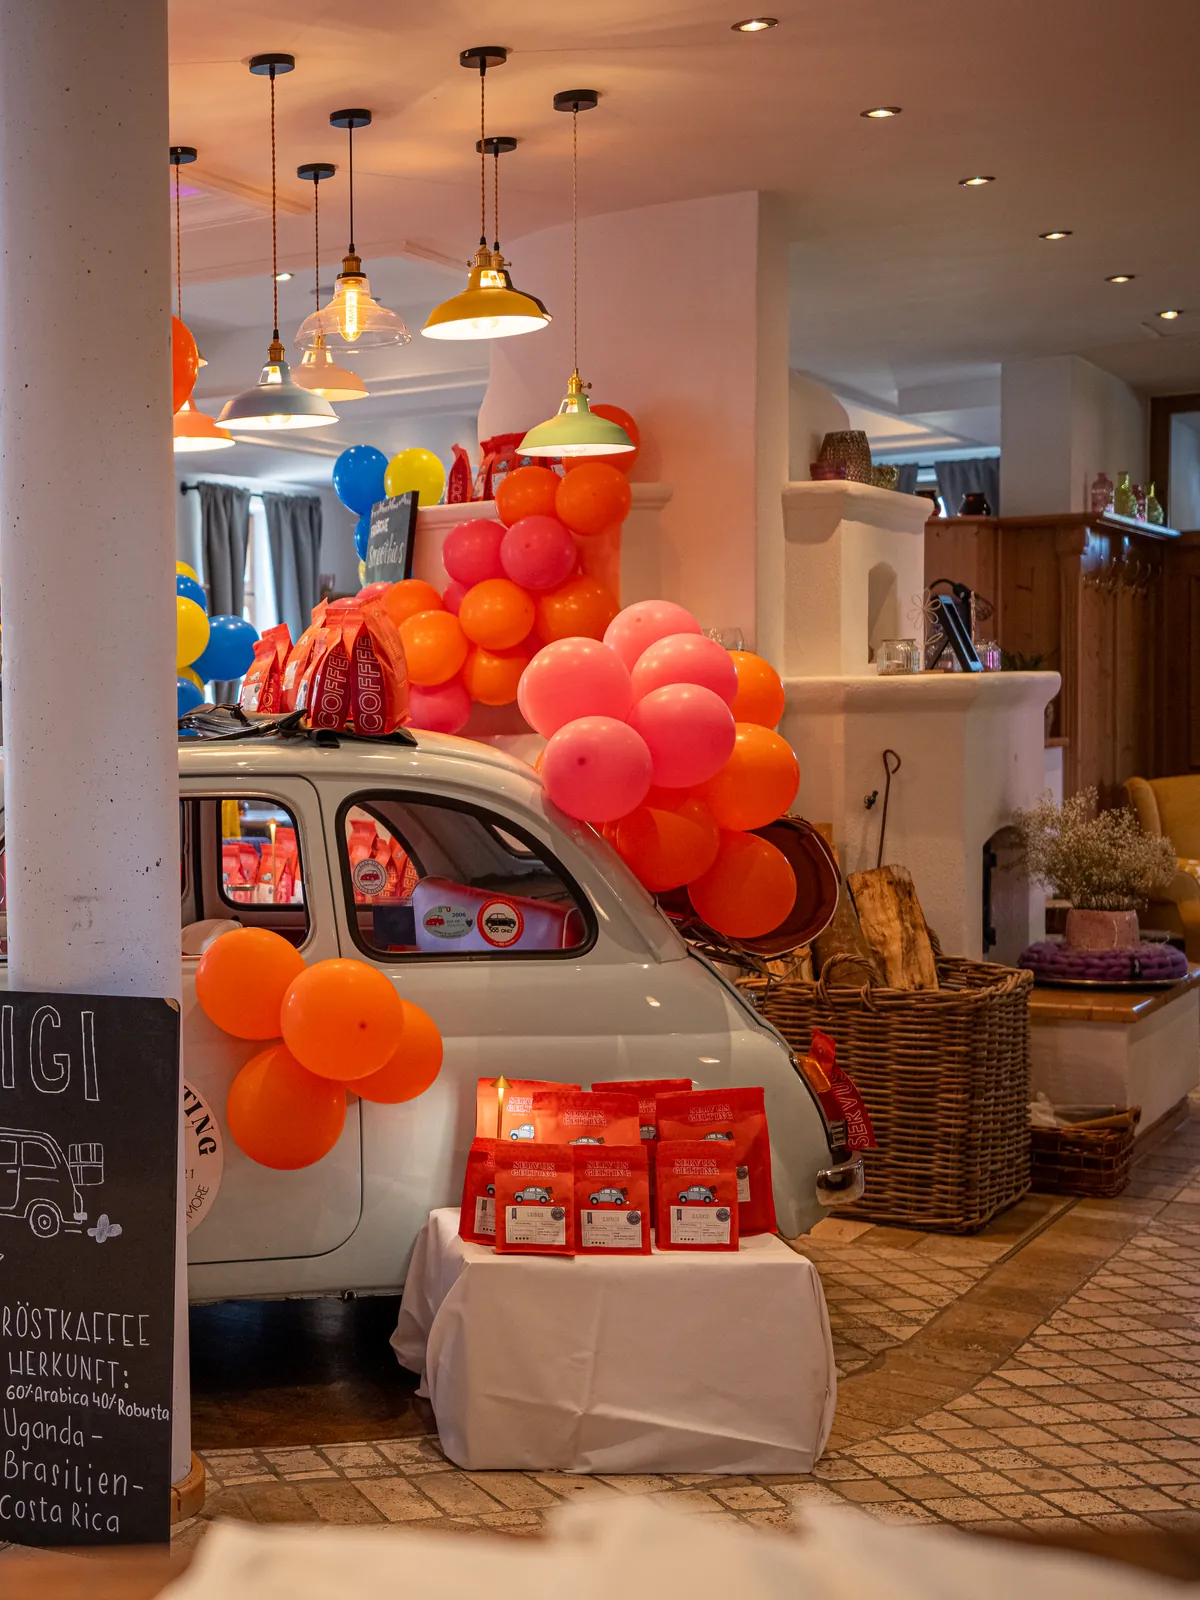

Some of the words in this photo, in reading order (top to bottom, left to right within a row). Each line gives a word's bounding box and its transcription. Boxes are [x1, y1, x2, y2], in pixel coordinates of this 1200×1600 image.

[356, 635, 383, 732] COFFEE
[508, 1096, 533, 1105] SERV
[831, 1072, 869, 1148] SERVUS
[183, 1086, 217, 1156] TING
[511, 1169, 556, 1178] GELTING
[512, 1161, 555, 1170] SERVUS
[672, 1166, 720, 1175] GELTING
[186, 1184, 210, 1218] MORE
[2, 1301, 150, 1346] RÖSTKAFFEE
[118, 1398, 170, 1421] Robusta
[3, 1407, 84, 1450] Uganda
[0, 1494, 62, 1524] Costa
[72, 1502, 120, 1534] Rica
